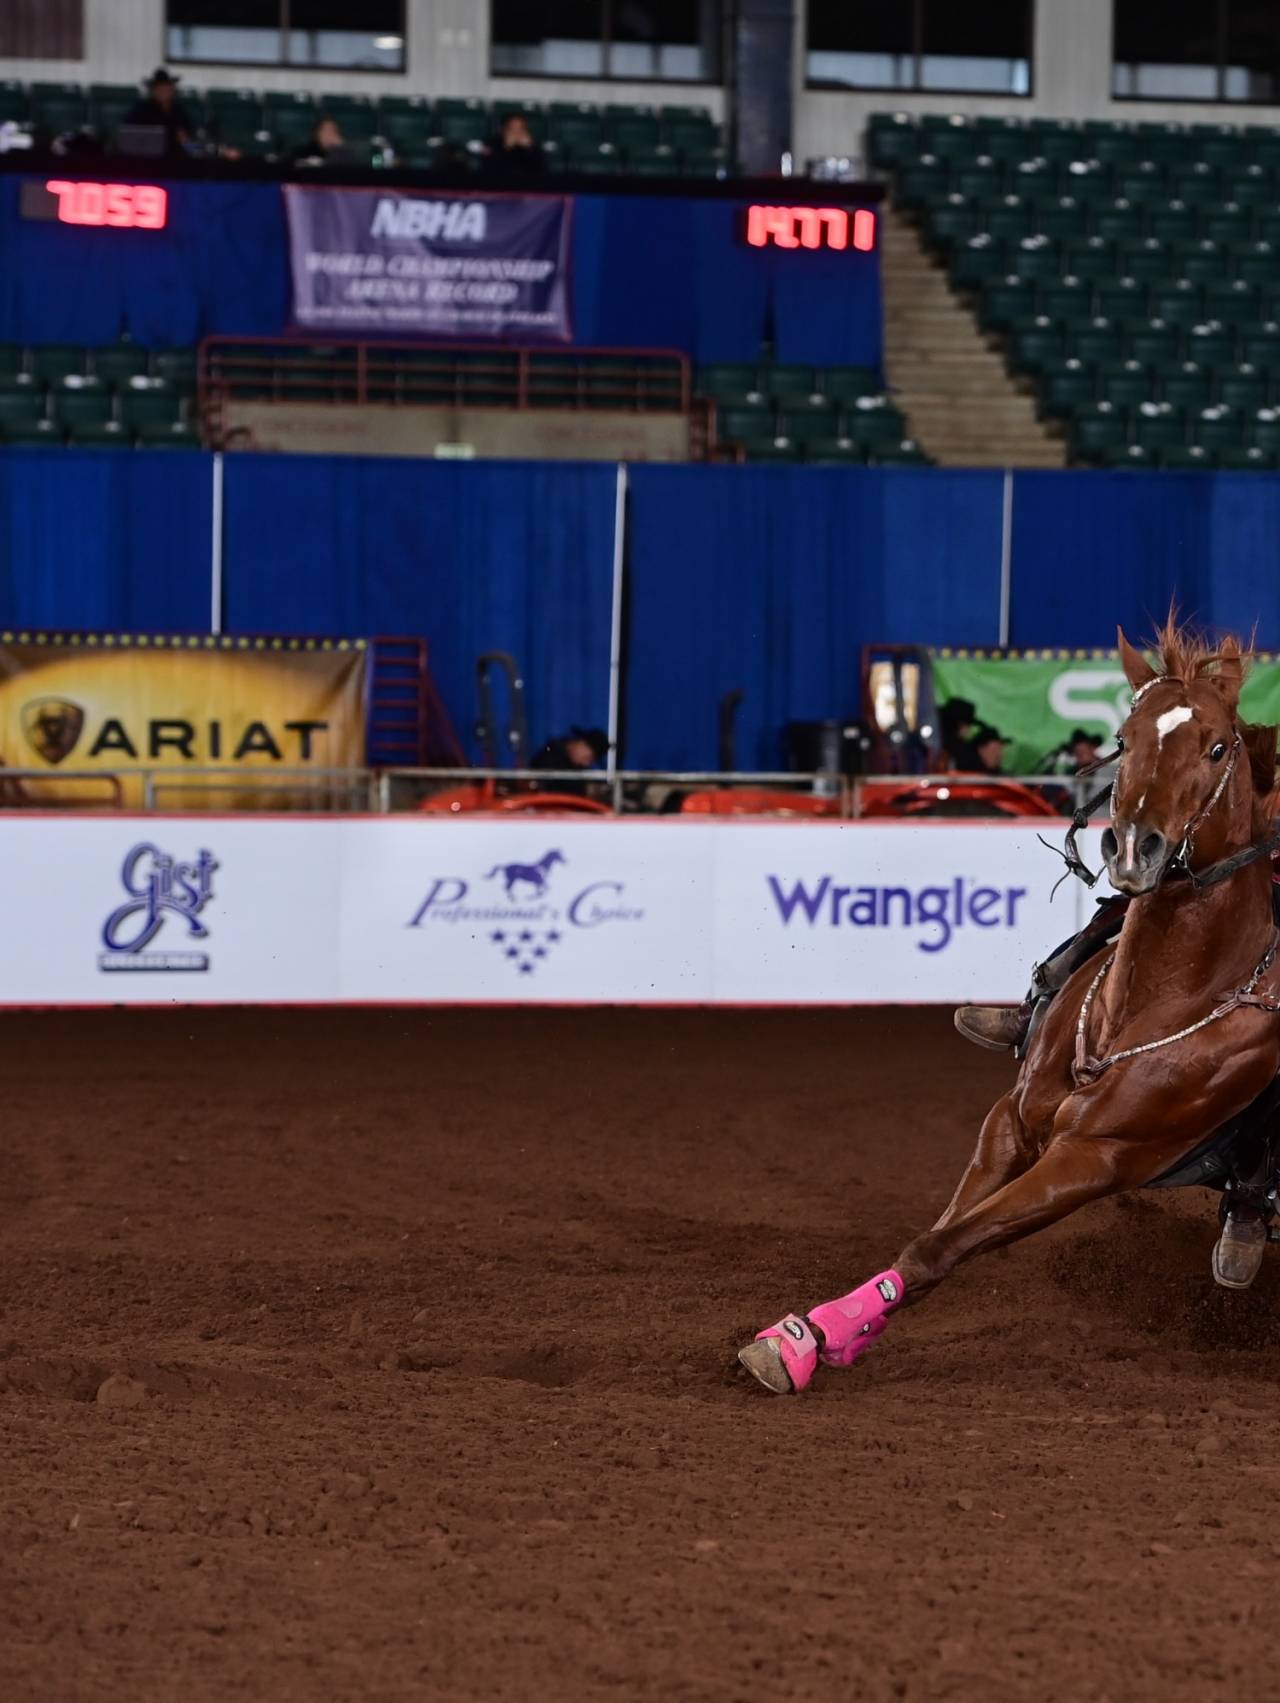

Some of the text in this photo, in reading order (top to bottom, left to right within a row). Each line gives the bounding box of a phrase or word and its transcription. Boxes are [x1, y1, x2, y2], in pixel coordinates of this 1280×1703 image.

[370, 199, 487, 241] NBHA
[88, 718, 328, 760] ARIAT
[102, 842, 219, 954] Gist
[406, 877, 645, 928] Professional's Choice
[767, 875, 1027, 953] Wrangler
